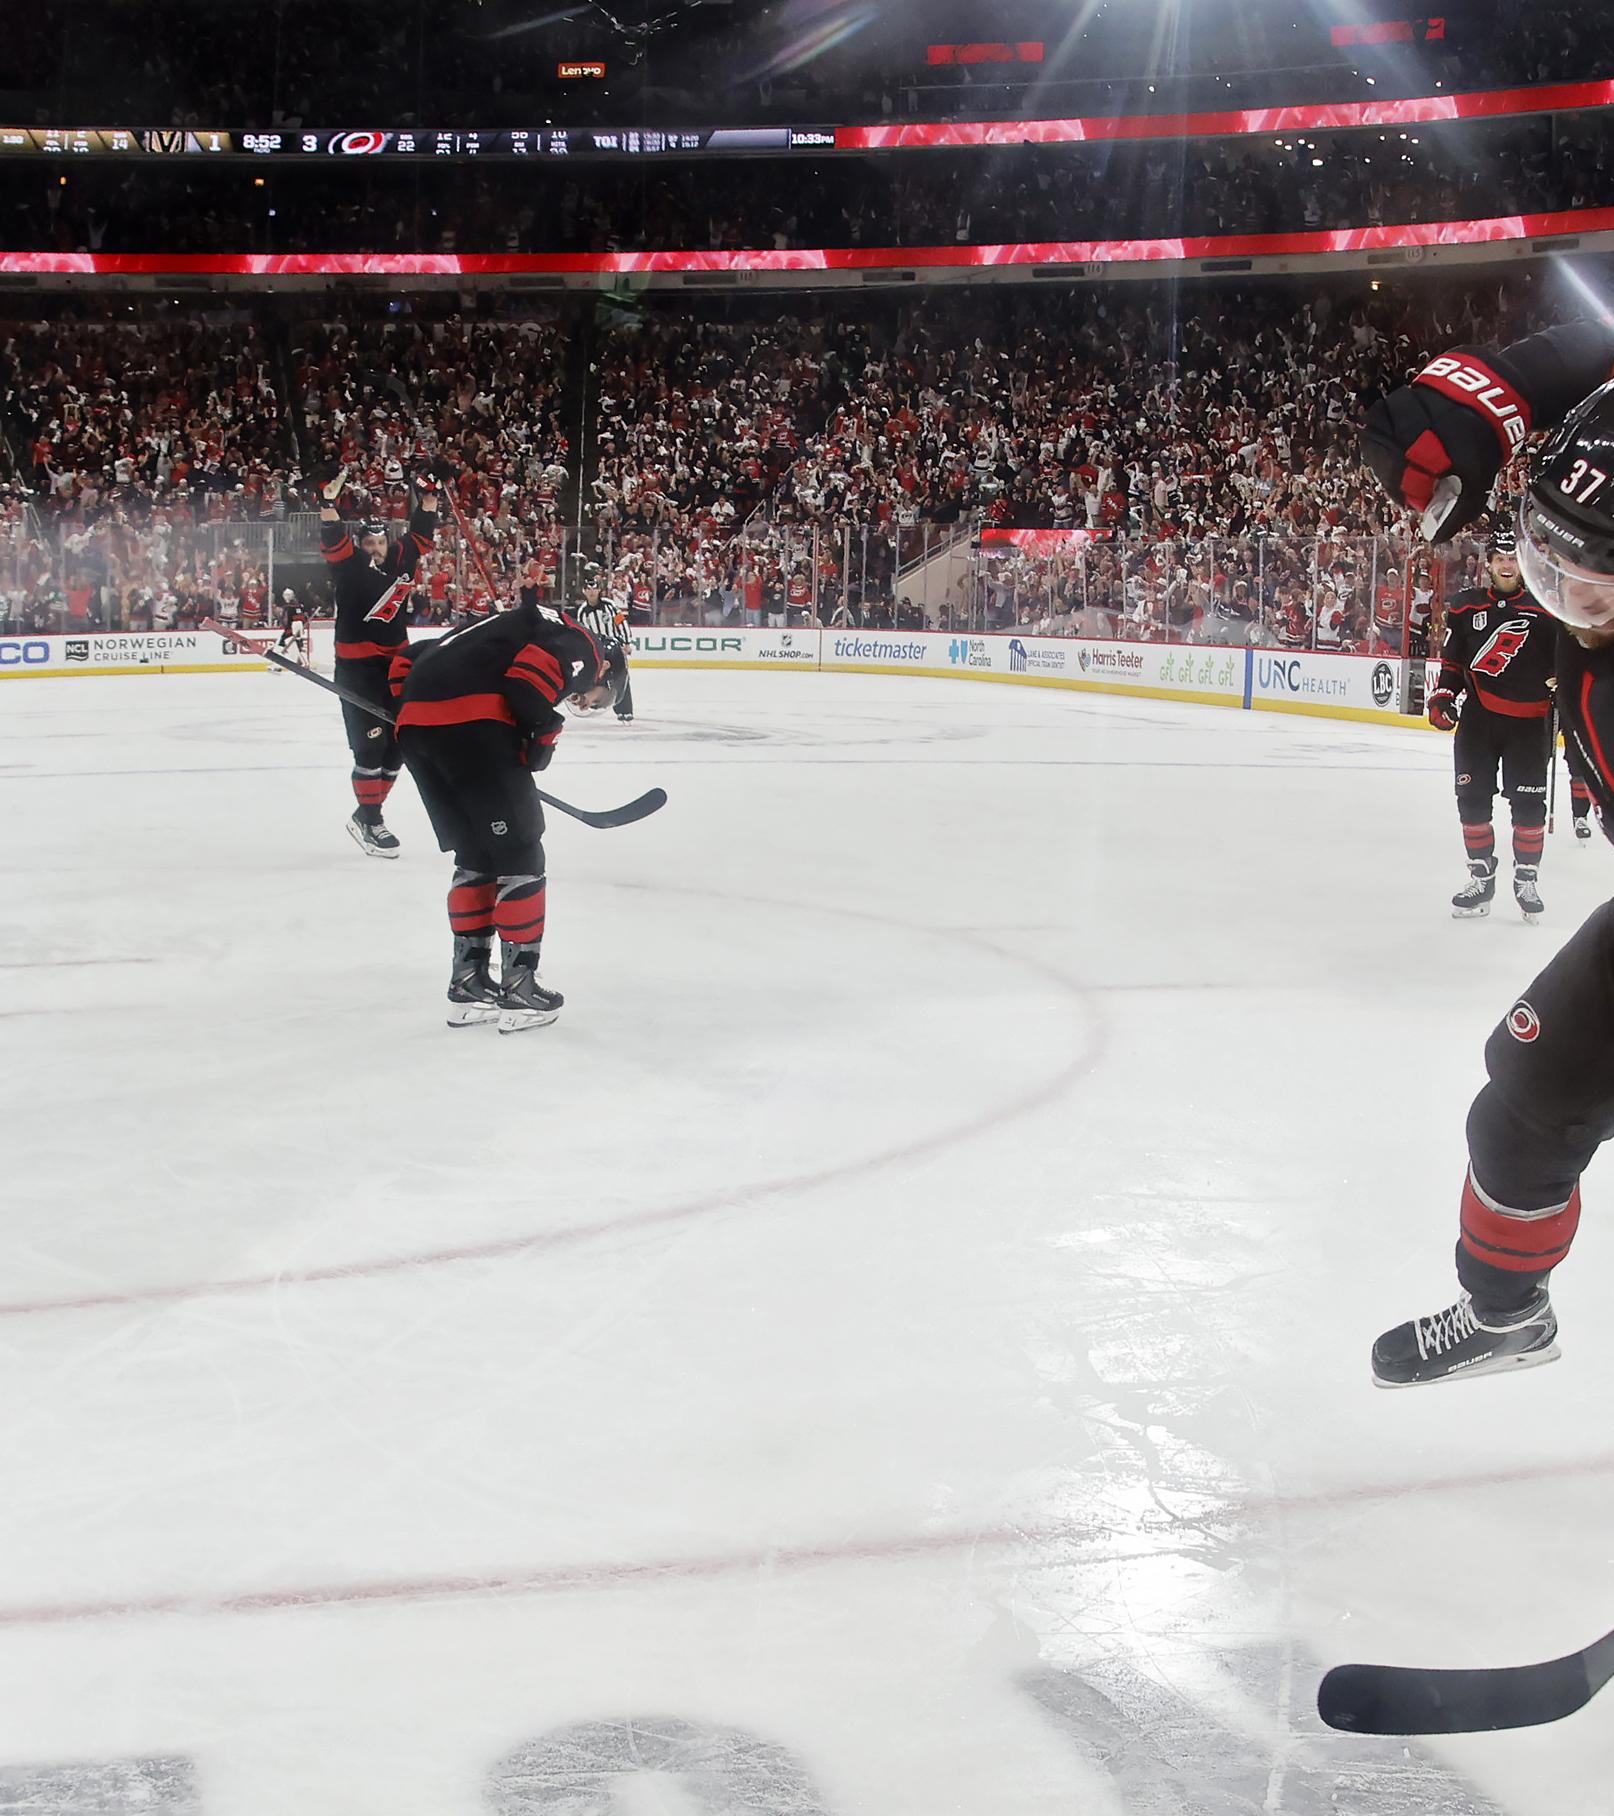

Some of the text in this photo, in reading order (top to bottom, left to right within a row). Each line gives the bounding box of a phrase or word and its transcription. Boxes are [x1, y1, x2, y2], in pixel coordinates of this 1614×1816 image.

[112, 138, 128, 150] 14
[209, 134, 221, 151] 1
[243, 134, 281, 148] 8:52
[302, 135, 317, 152] 3
[397, 141, 415, 151] 22
[593, 135, 618, 148] TOI
[1560, 459, 1606, 504] 37
[1536, 513, 1585, 548] BAUER
[67, 644, 88, 655] NCL
[94, 637, 197, 650] NORWEGIAN
[834, 637, 928, 660] ticketmaster
[969, 639, 986, 652] North
[94, 651, 171, 662] CRUISE LINE
[968, 653, 992, 667] Carolina
[1092, 648, 1144, 669] Harris Teeter
[1259, 657, 1347, 696] UNC HEALTH
[1373, 672, 1392, 695] LBC
[1517, 785, 1546, 793] BAUE
